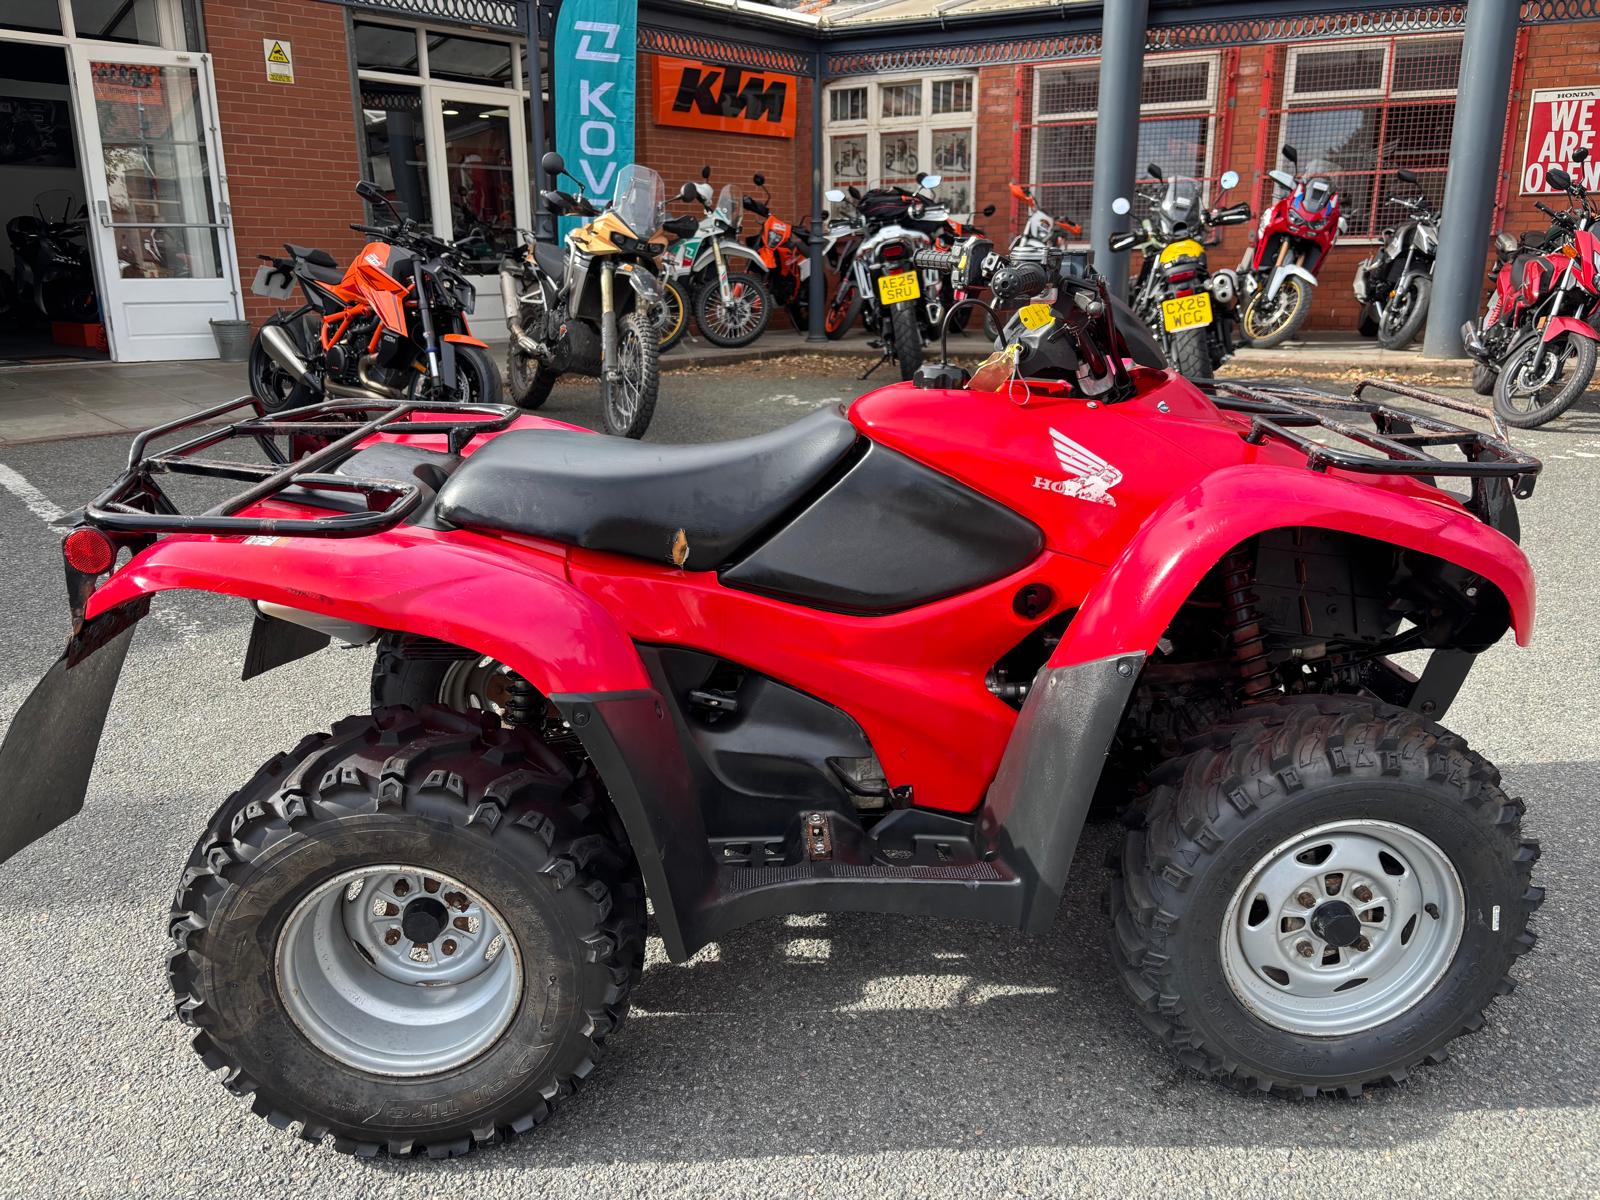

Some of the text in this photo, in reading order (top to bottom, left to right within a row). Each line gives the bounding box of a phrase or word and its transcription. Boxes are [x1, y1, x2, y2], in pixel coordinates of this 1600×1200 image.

[672, 63, 788, 123] KTM
[1557, 91, 1595, 99] HONDA
[1550, 99, 1596, 132] WE
[1537, 131, 1597, 163] ARE
[882, 274, 915, 290] AE25
[887, 286, 912, 300] SRU
[1166, 296, 1206, 315] CX26
[1173, 310, 1203, 327] WCG
